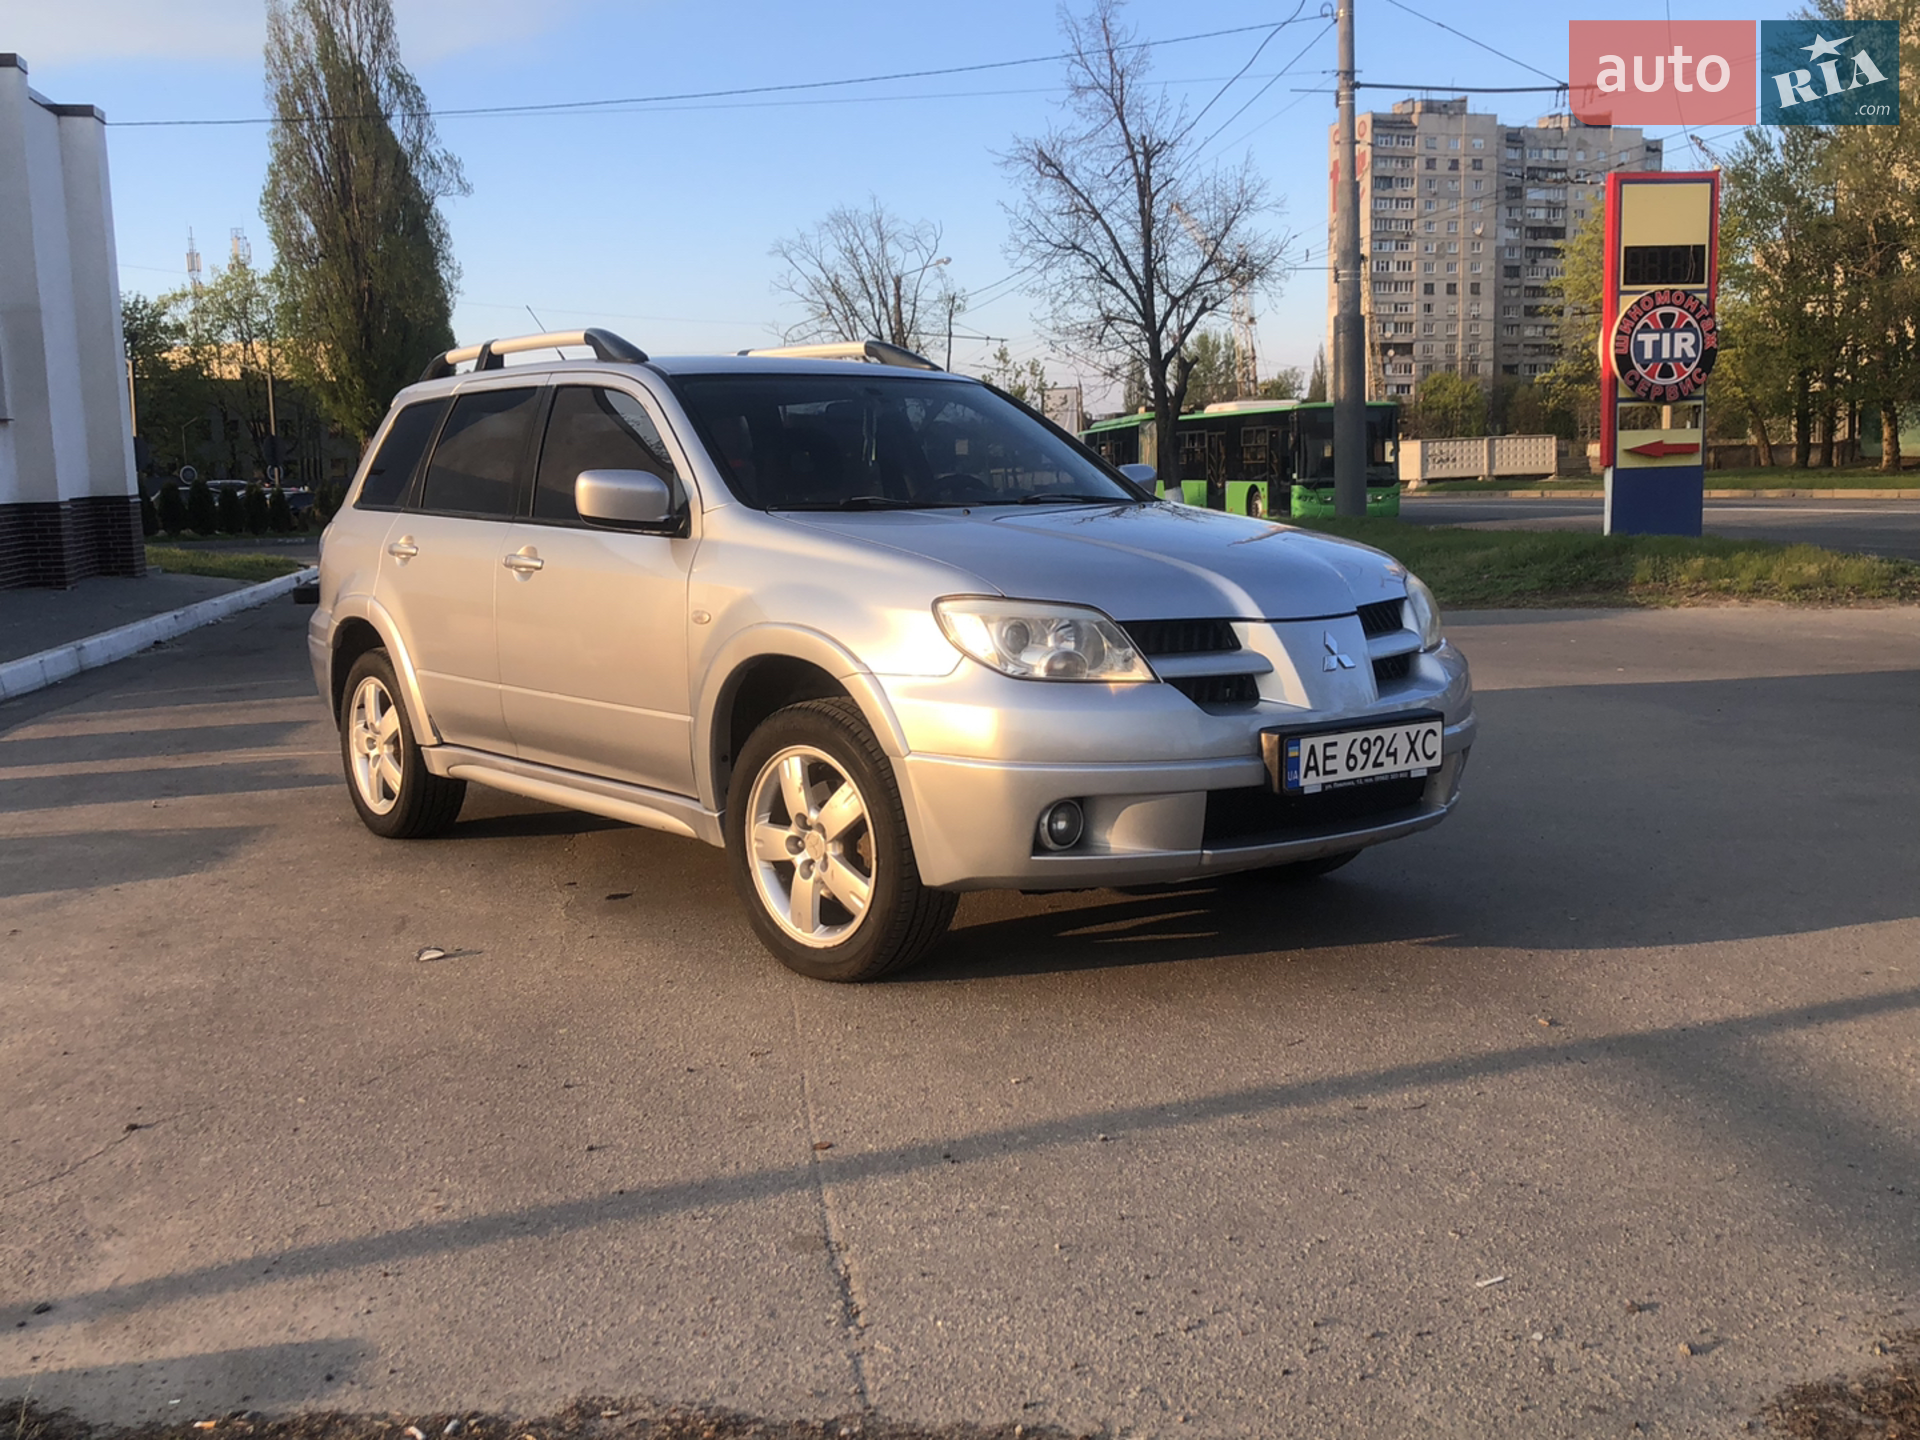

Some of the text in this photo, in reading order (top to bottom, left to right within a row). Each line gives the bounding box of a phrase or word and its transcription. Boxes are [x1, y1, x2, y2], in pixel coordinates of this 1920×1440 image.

[1637, 332, 1697, 360] TIR
[1624, 367, 1708, 402] СЕРВИС
[1303, 728, 1438, 779] AE 6924 XC
[1287, 770, 1299, 782] UA
